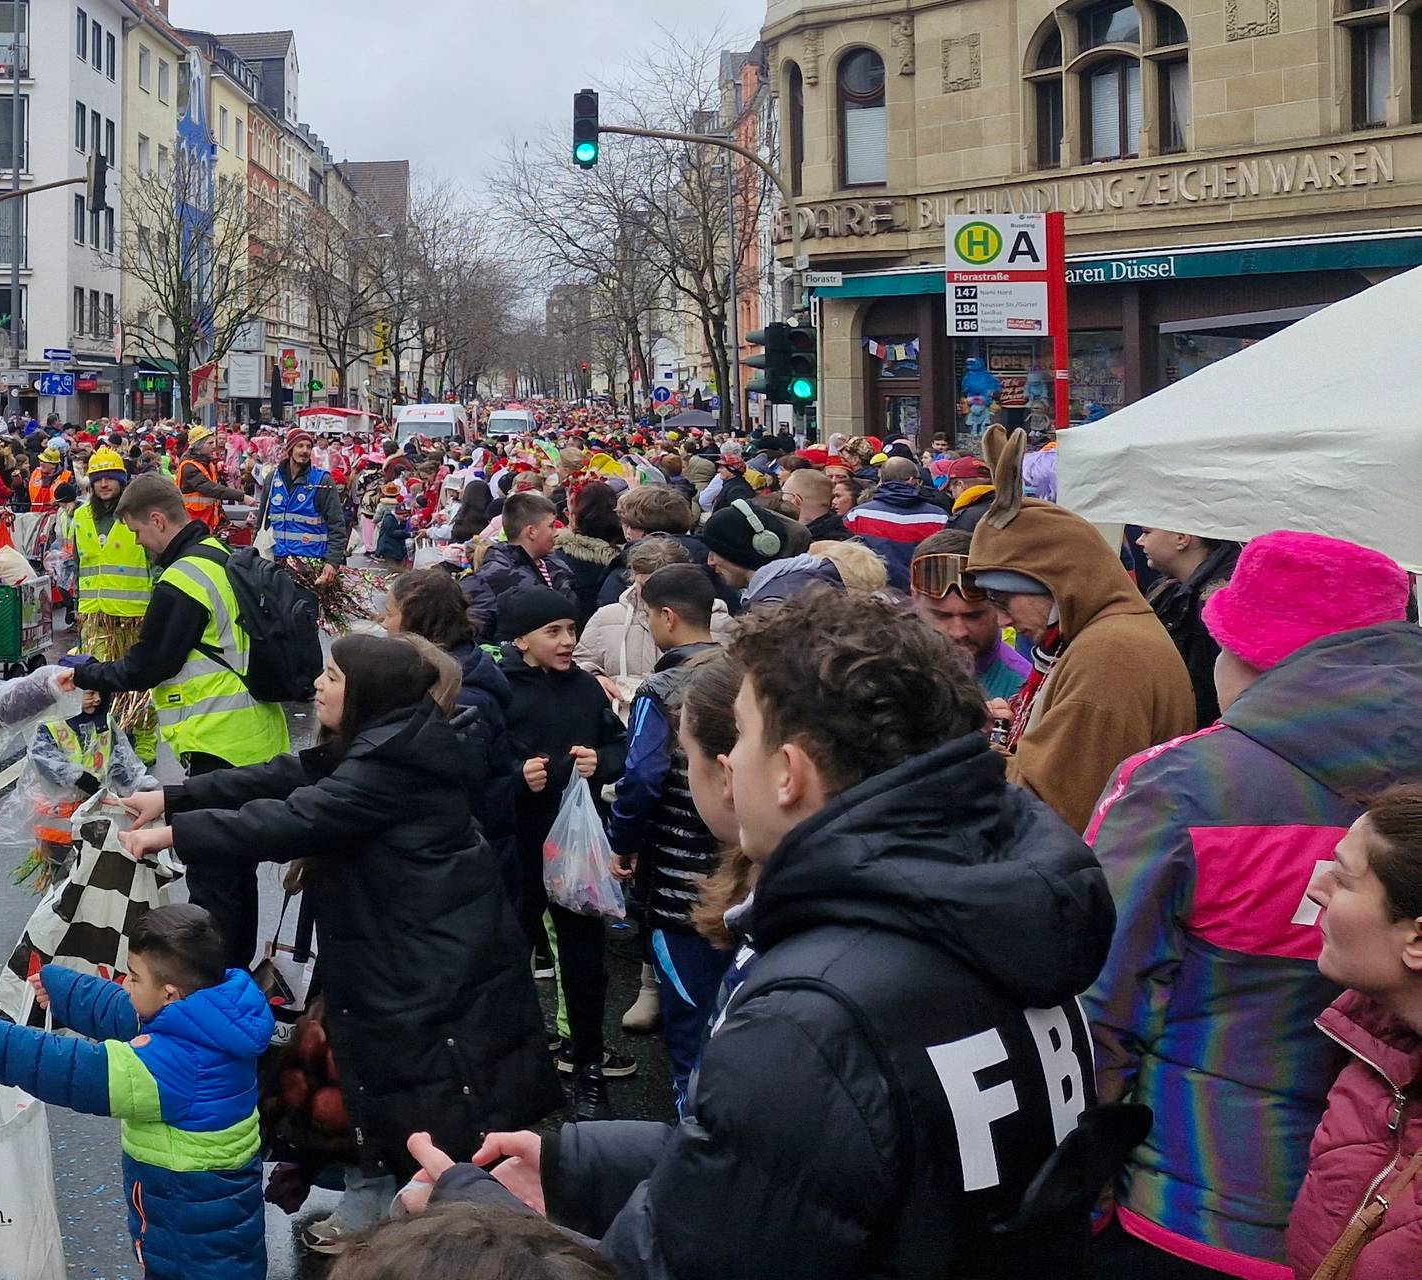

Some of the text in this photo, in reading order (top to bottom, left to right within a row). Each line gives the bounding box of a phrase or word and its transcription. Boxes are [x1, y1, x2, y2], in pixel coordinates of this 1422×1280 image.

[967, 230, 1041, 263] H A
[1110, 256, 1176, 281] Düssel
[805, 274, 841, 283] Florastr.
[953, 272, 1010, 282] Florastraße
[956, 288, 977, 297] 147
[956, 304, 977, 314] 184
[956, 320, 978, 331] 186
